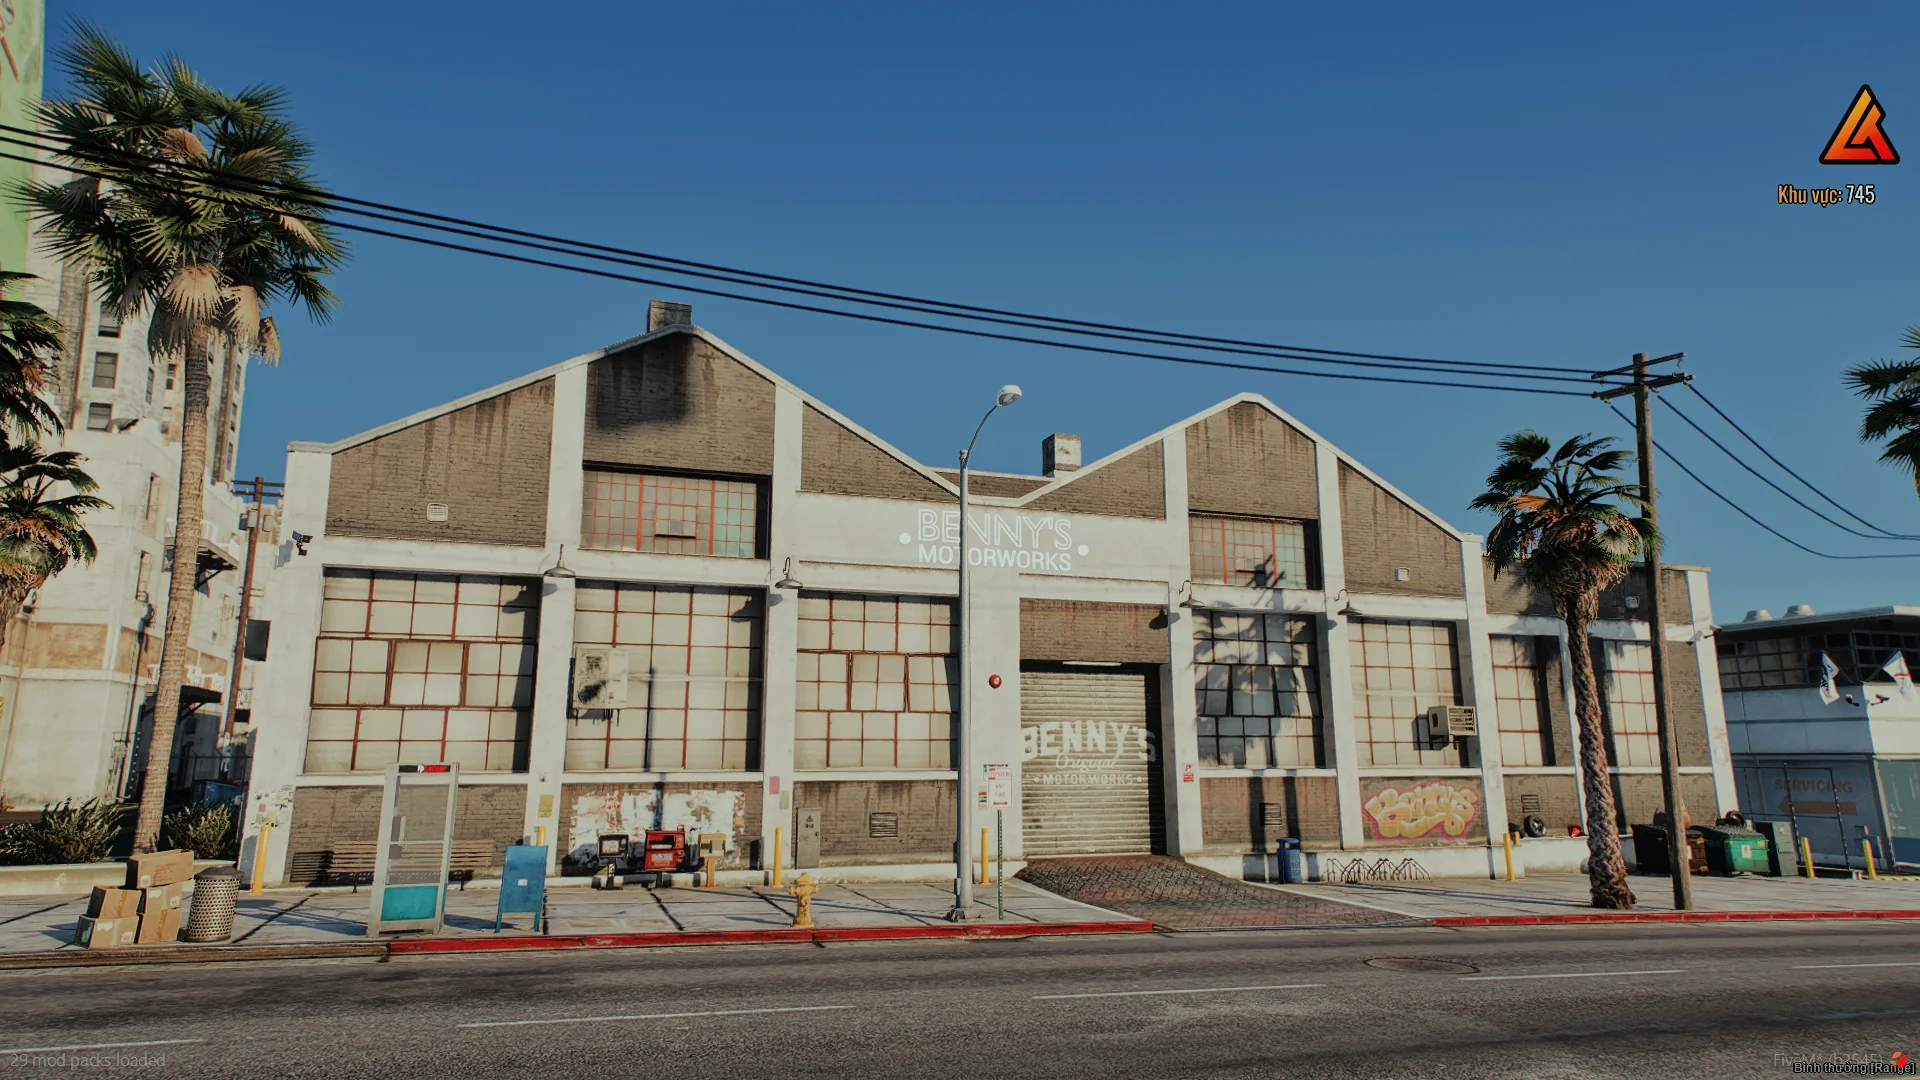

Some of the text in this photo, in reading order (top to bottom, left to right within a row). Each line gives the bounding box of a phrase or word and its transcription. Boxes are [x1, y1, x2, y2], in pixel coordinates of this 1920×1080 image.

[918, 509, 1072, 550] BENNY'S
[1020, 720, 1156, 762] BENNY'S
[1043, 774, 1133, 785] MOTORWORKS
